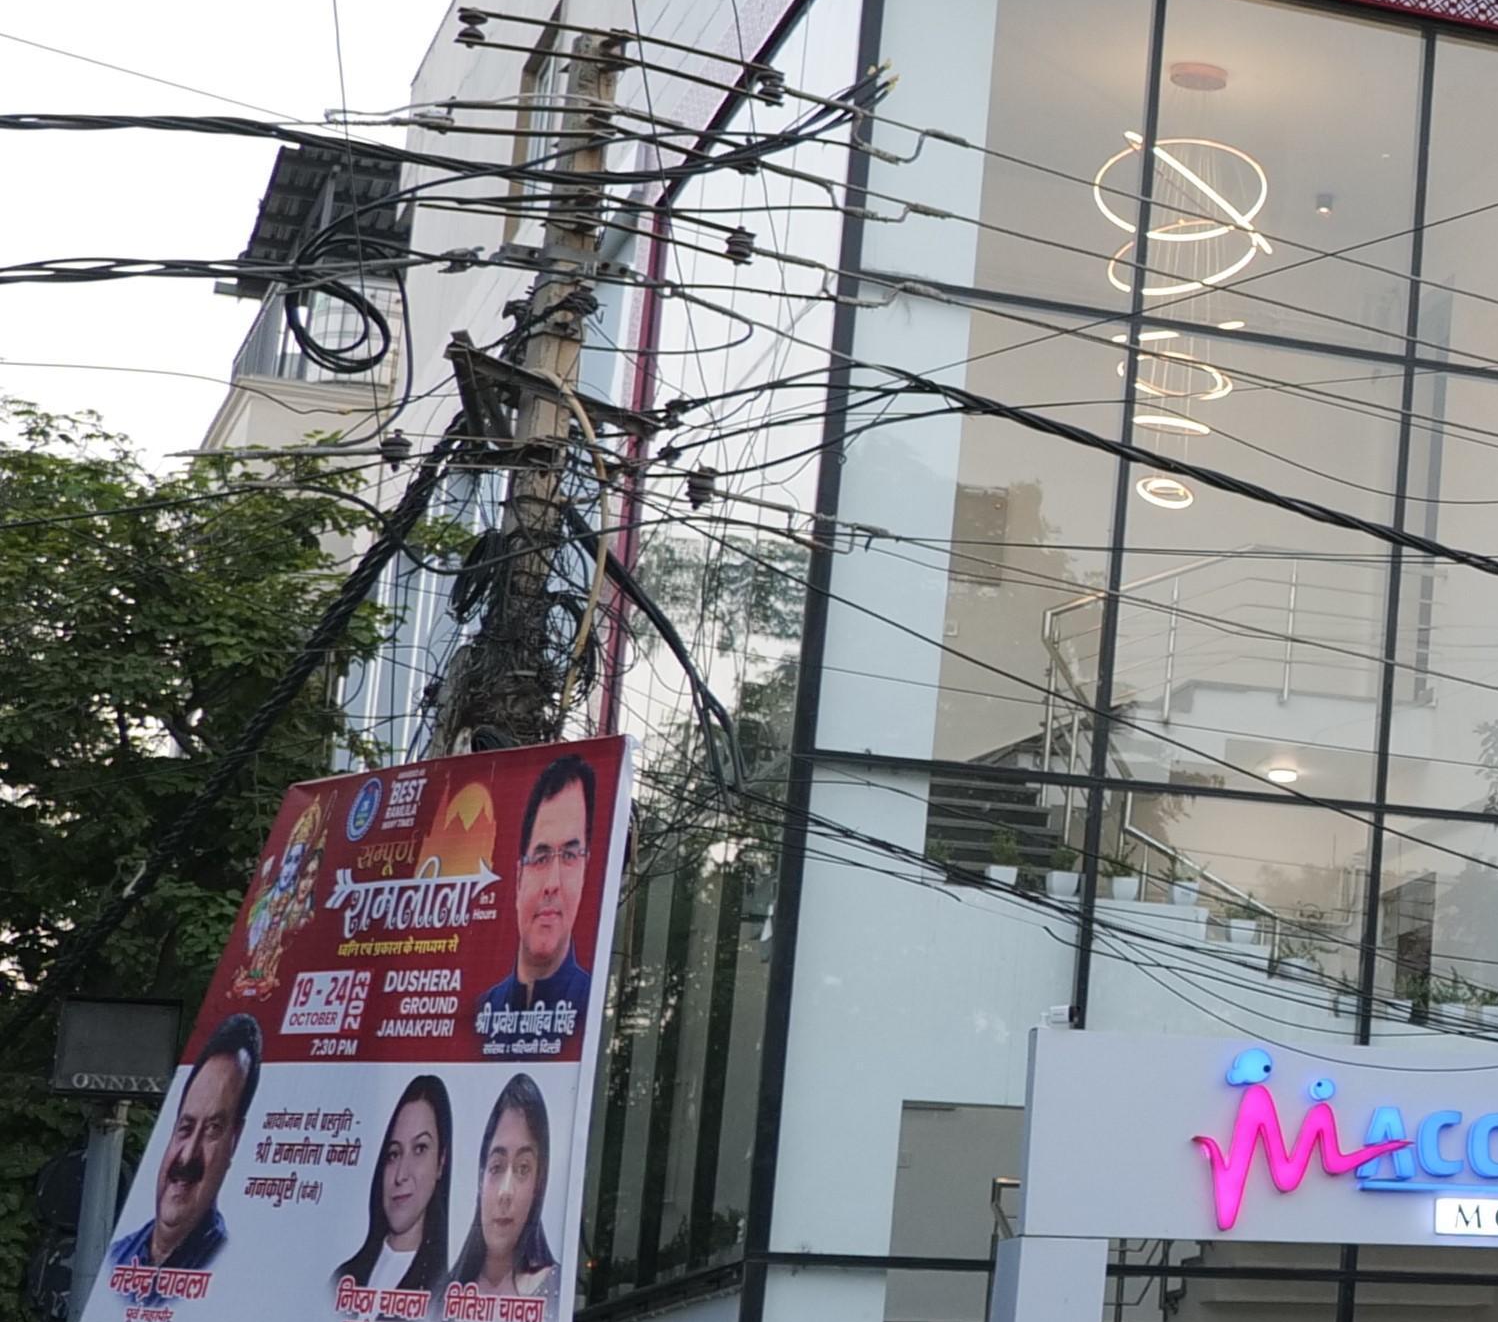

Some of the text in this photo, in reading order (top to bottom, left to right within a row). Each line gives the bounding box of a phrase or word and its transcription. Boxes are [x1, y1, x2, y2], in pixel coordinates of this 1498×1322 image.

[335, 856, 488, 938] रामलीला
[293, 977, 312, 1007] 19
[324, 975, 351, 1006] 24
[384, 969, 462, 993] DUSHERA
[343, 970, 371, 1030] 2023
[400, 996, 458, 1015] GROUND
[289, 1011, 338, 1026] OCTOBER
[376, 1019, 455, 1038] JANAKPURI
[475, 999, 578, 1038] श्री प्रवेश साहिब सिंह
[310, 1038, 358, 1056] 7:30 PM
[71, 1072, 163, 1093] ONNYX
[262, 1107, 304, 1130] आयोजन
[304, 1107, 320, 1131] एवं
[255, 1135, 272, 1164] श्री
[244, 1171, 298, 1208] जनकपुरी
[110, 1256, 213, 1301] नरेन्द्र चावला
[378, 1289, 431, 1319] चावला
[444, 1282, 496, 1322] नितिशा
